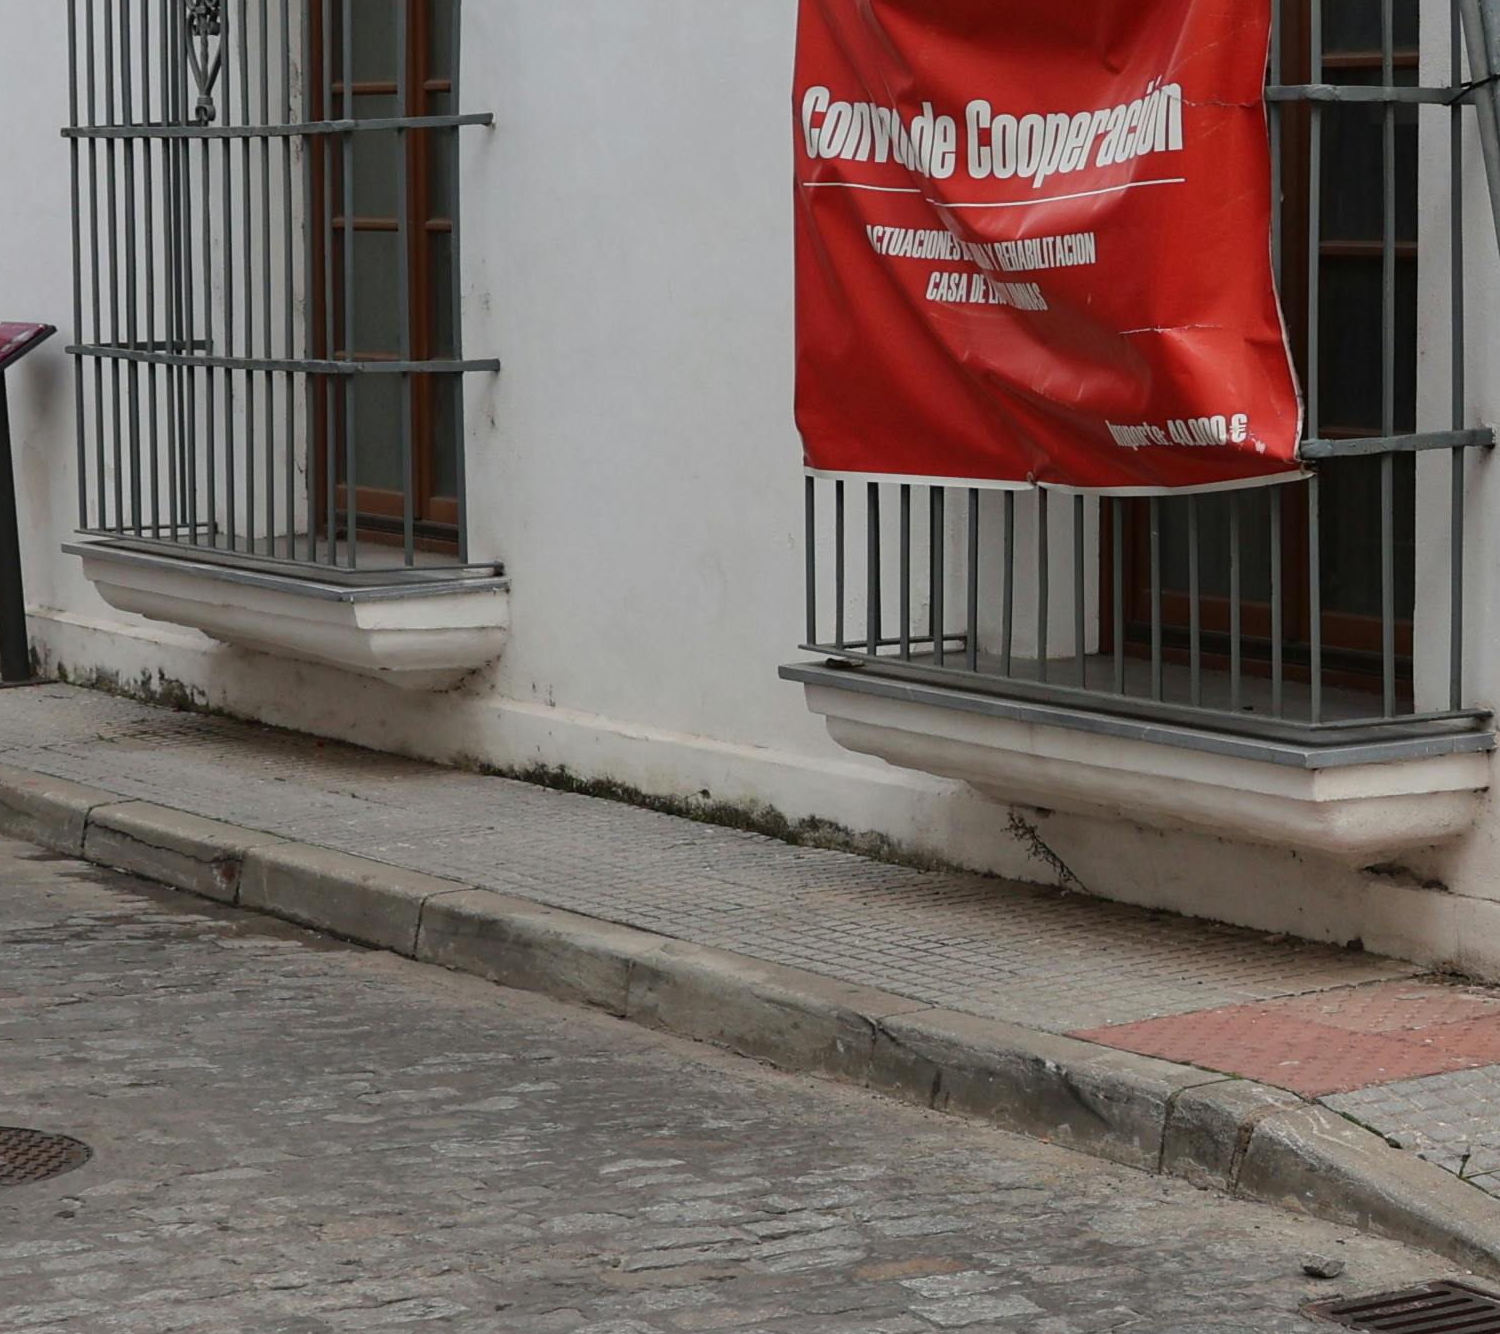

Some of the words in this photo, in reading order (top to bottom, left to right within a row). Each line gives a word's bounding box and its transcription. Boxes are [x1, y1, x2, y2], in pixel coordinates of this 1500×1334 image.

[910, 101, 956, 179] de
[965, 75, 1183, 188] Cooperación
[993, 232, 1096, 272] REHABILITACION
[926, 271, 968, 302] CASA
[969, 273, 986, 303] DE
[1105, 419, 1173, 451] Importe:
[1167, 415, 1227, 446] 40.000
[1229, 413, 1248, 443] €
